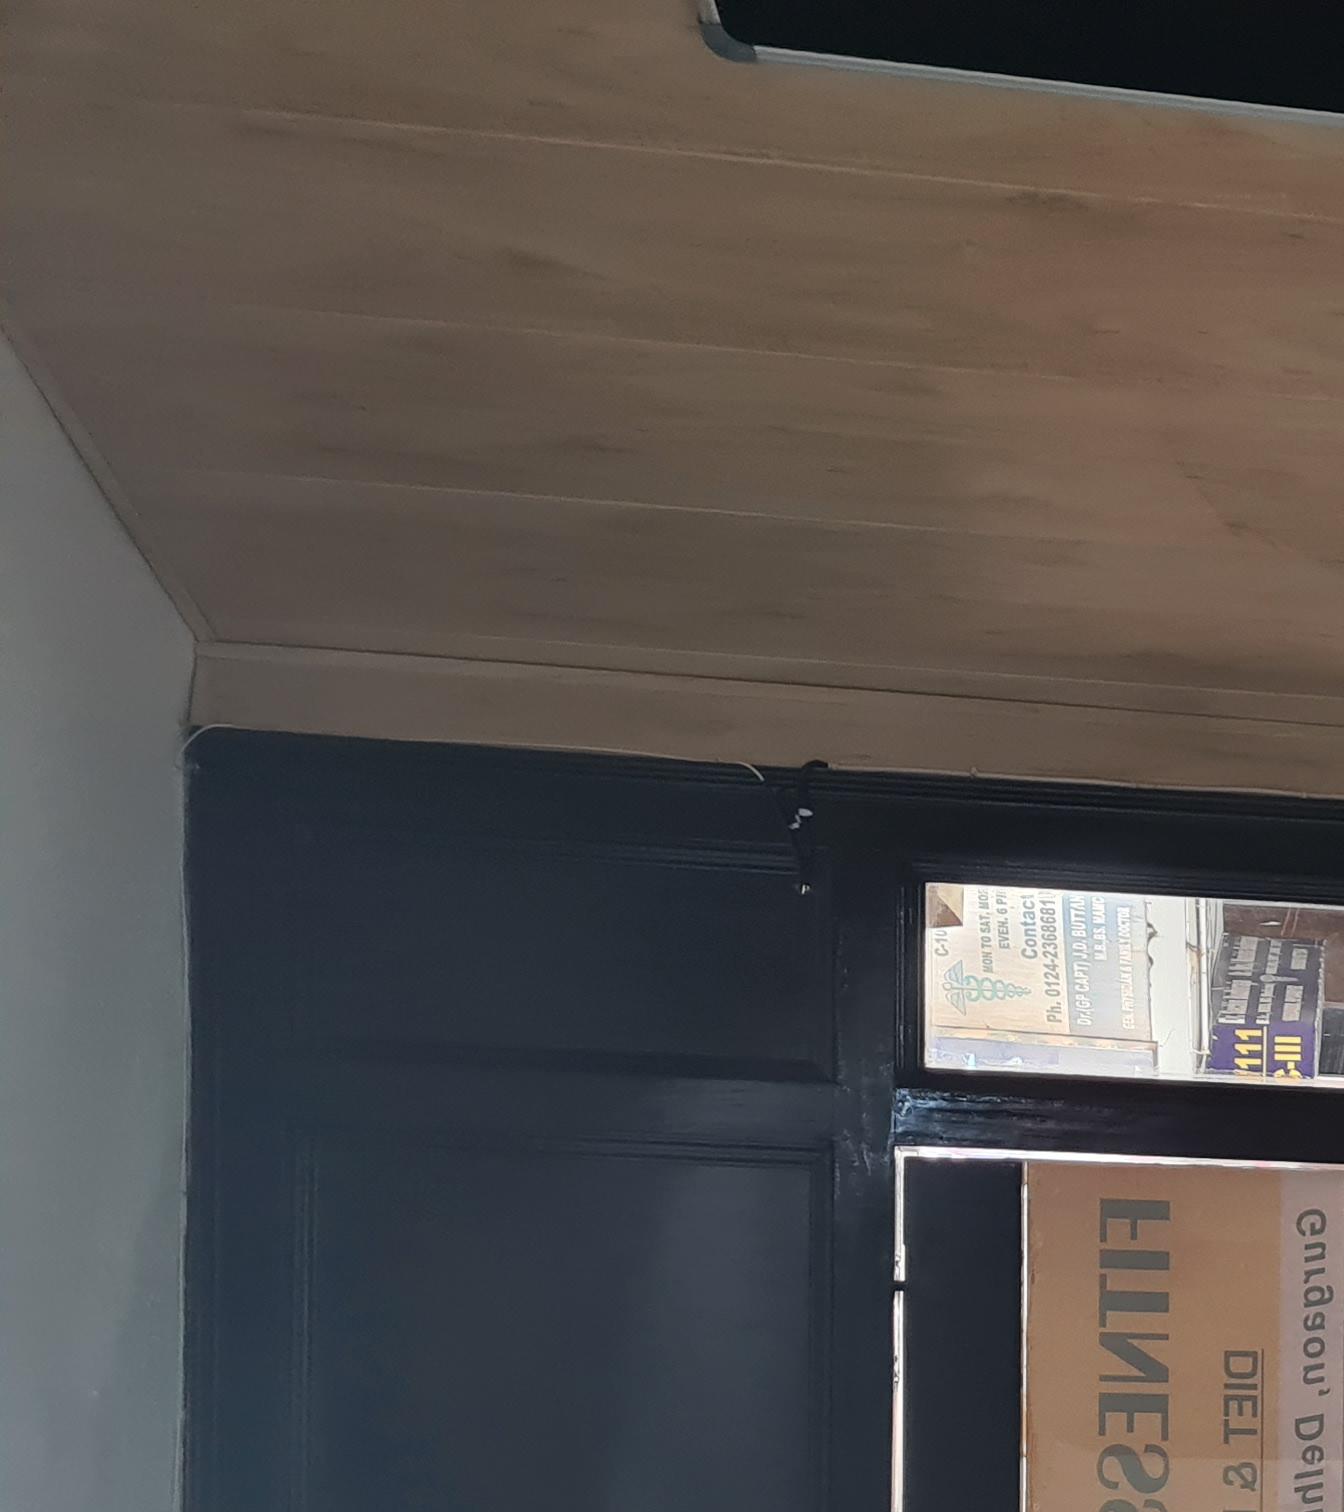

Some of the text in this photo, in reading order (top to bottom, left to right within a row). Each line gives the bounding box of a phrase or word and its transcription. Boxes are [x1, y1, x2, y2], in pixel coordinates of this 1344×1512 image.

[997, 907, 1007, 915] 6
[1020, 894, 1038, 959] Contact
[980, 936, 991, 948] TO
[982, 952, 993, 973] MON
[1046, 1002, 1062, 1023] Ph.
